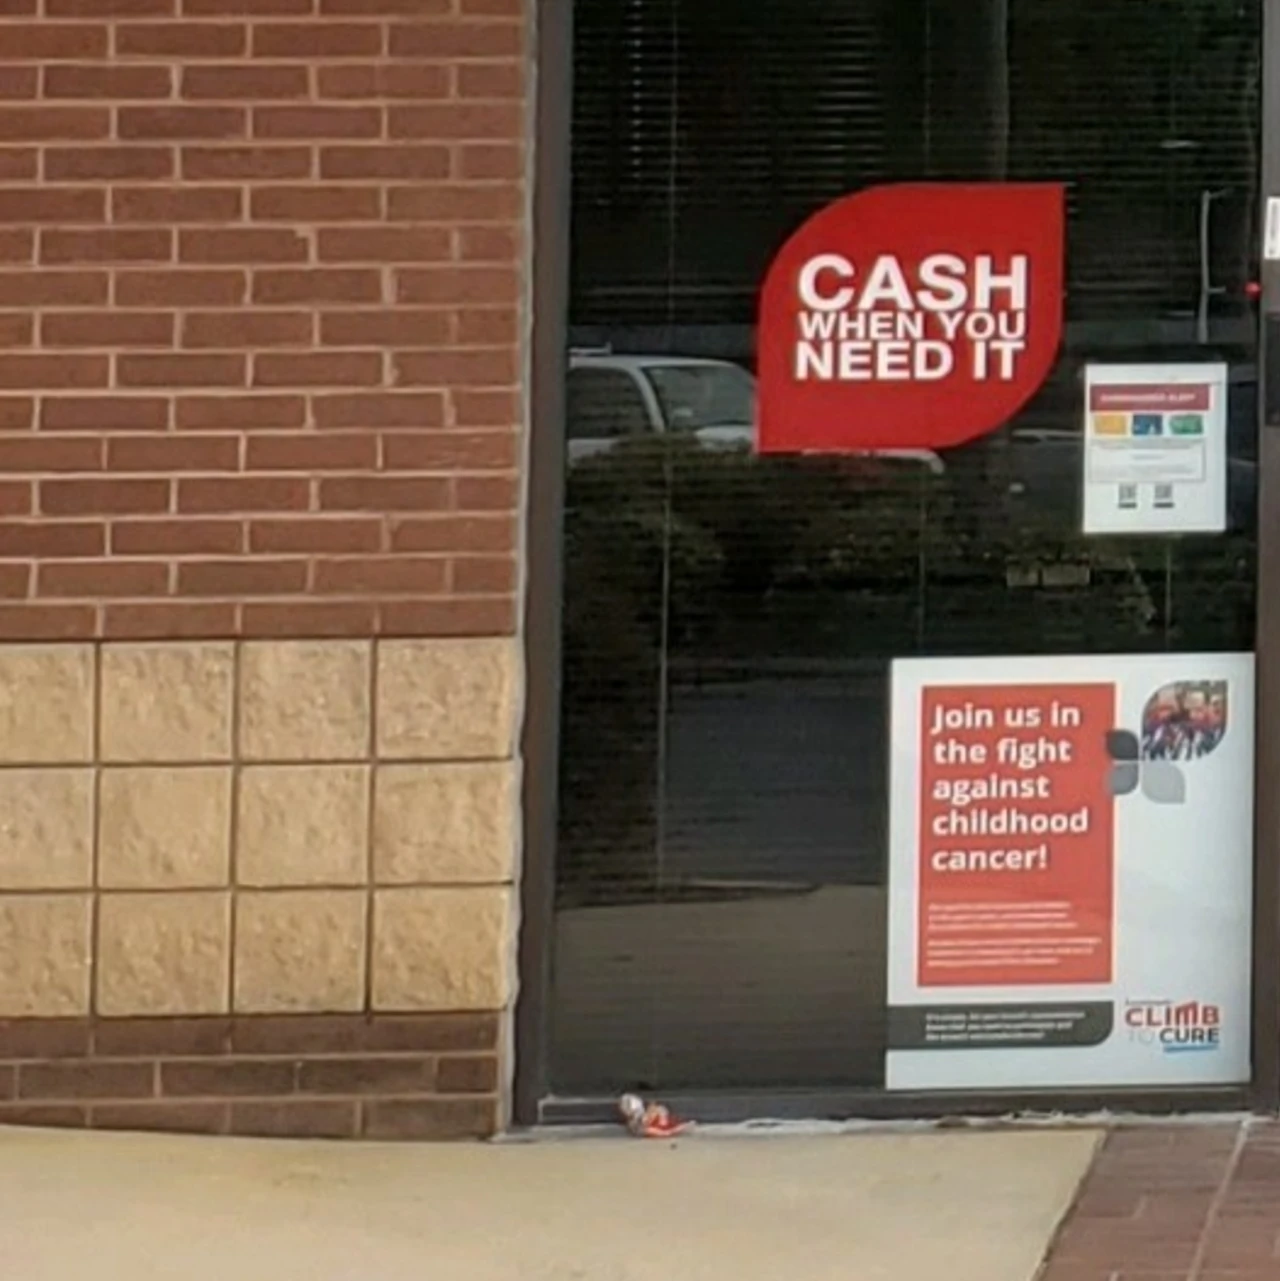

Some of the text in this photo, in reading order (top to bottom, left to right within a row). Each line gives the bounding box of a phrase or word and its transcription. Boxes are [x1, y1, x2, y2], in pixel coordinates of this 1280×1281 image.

[797, 254, 1028, 311] CASH
[798, 311, 1026, 340] WHEN YOU
[795, 340, 1026, 380] NEED IT
[930, 701, 1080, 735] Join us in
[933, 737, 1072, 769] the fight
[933, 773, 1050, 806] against
[932, 807, 1089, 835] childhood
[931, 843, 1047, 871] cancer!
[1125, 1001, 1220, 1026] CLIMB
[1159, 1027, 1220, 1044] CURE
